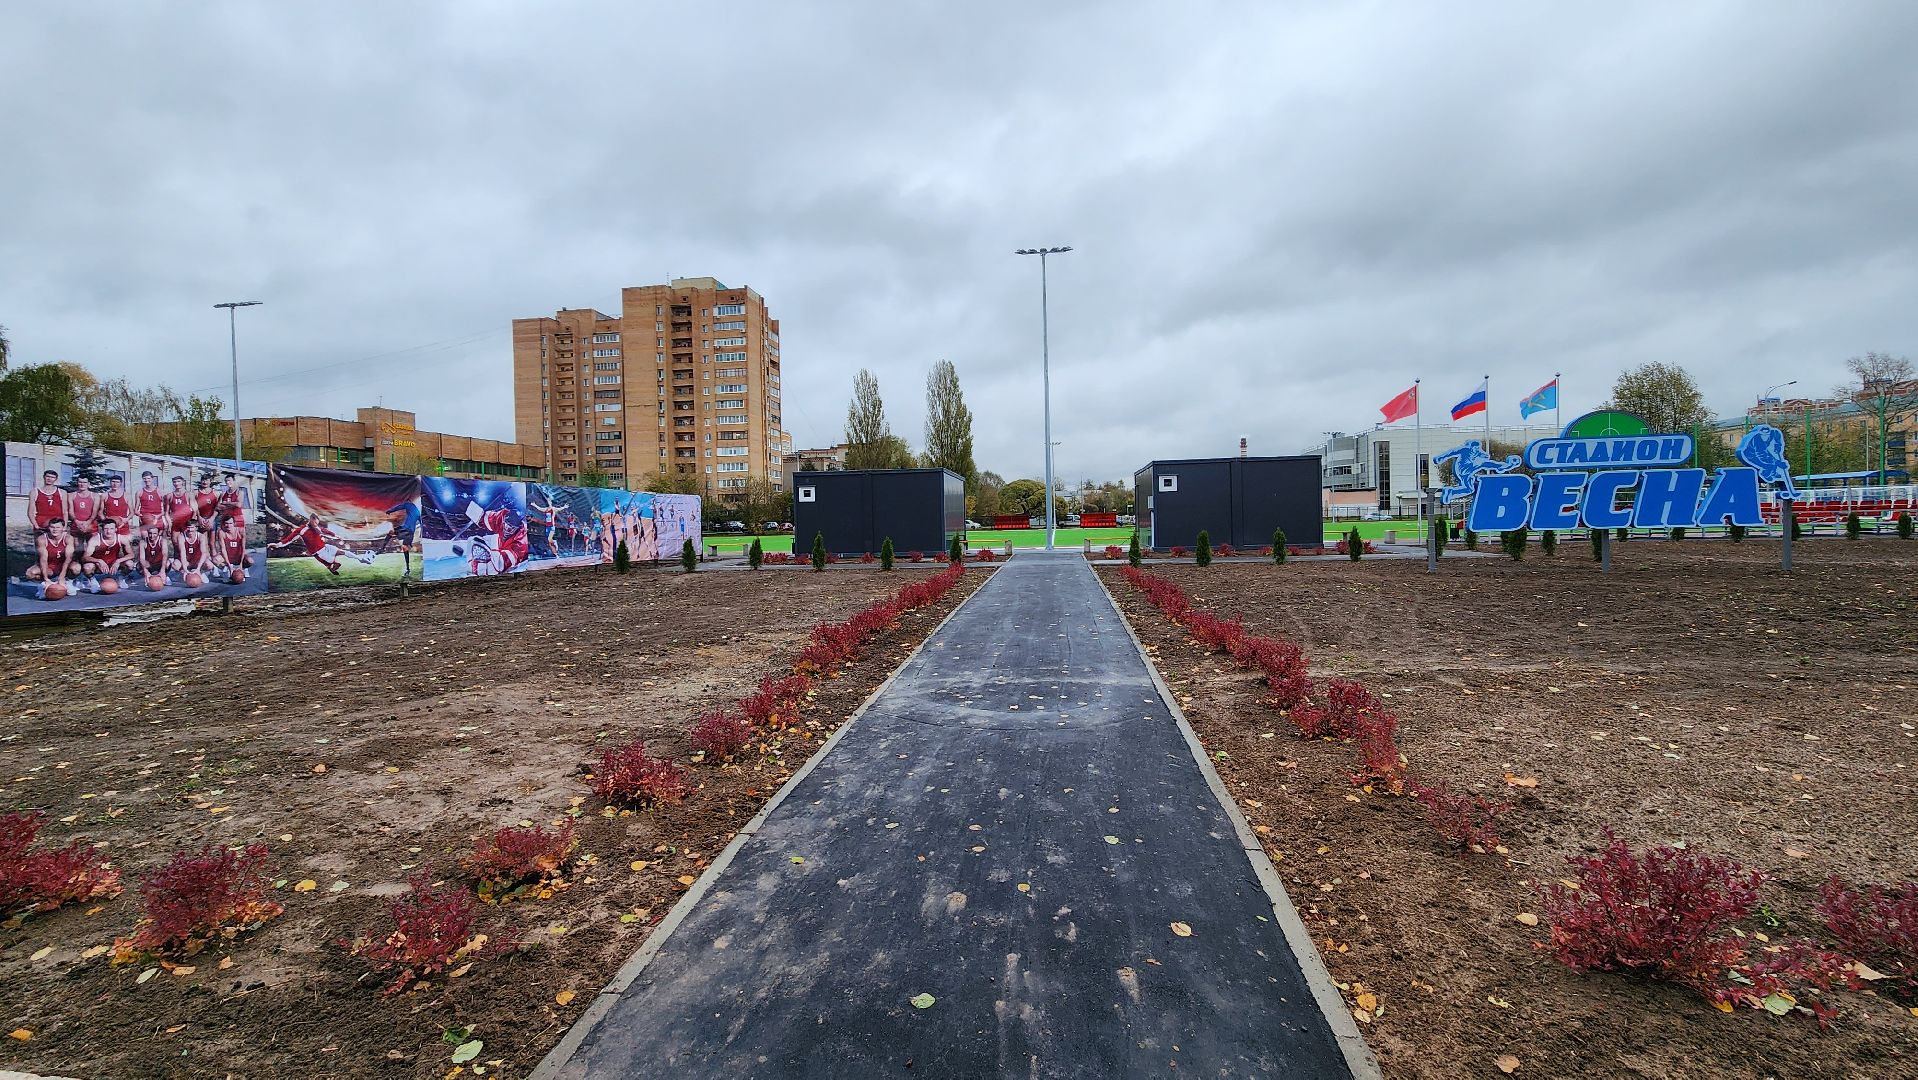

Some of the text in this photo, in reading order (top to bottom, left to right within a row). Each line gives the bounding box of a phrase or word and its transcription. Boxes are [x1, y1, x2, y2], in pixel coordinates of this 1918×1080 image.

[394, 440, 416, 448] BRAVO
[1535, 438, 1685, 464] СТАДИОН
[1467, 467, 1765, 532] ВЕСНА
